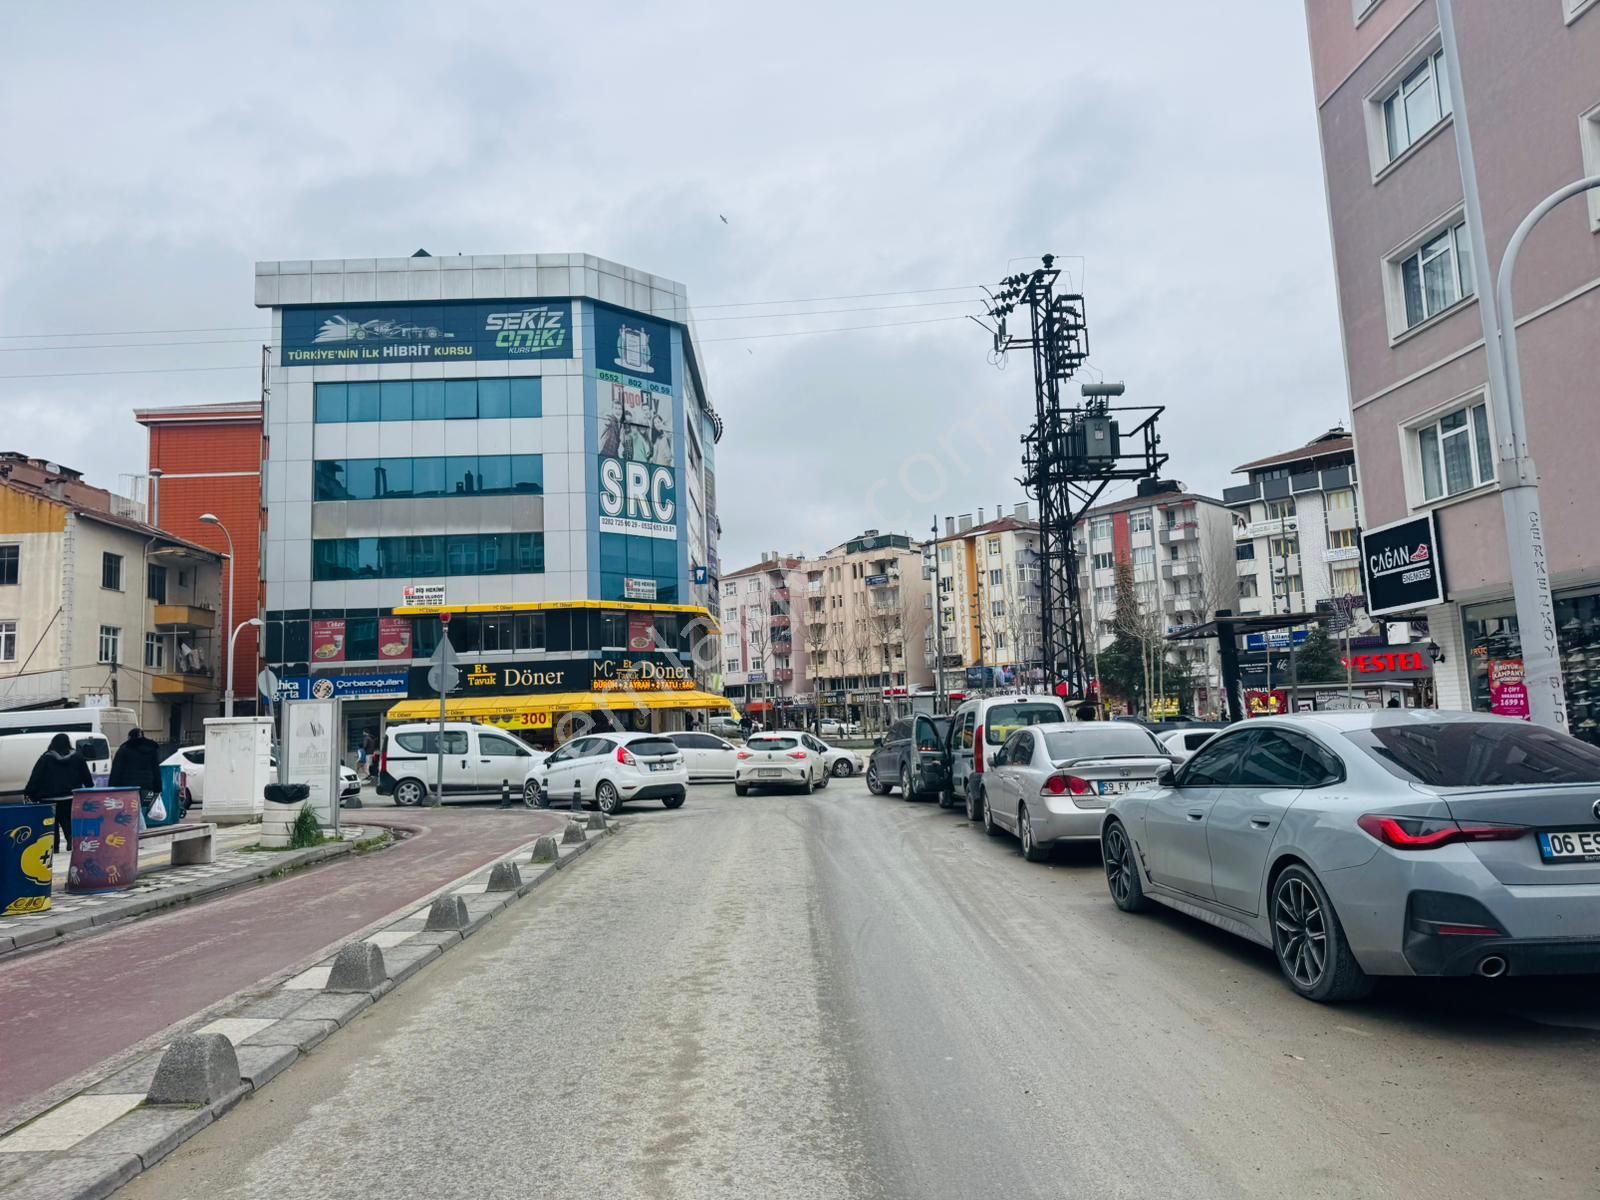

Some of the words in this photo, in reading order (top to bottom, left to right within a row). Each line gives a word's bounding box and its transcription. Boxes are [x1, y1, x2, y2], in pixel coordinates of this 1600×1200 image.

[288, 350, 358, 360] TÜRKİYE'NİN
[362, 349, 379, 358] İLK
[383, 345, 430, 357] HİBRİT
[434, 346, 472, 356] KURSU
[599, 372, 619, 383] 0552
[628, 379, 642, 388] 802
[600, 457, 675, 522] SRC
[1370, 546, 1409, 578] ÇAĞAN
[474, 664, 488, 673] Et
[623, 660, 632, 668] Et
[642, 661, 691, 679] Döner
[1341, 652, 1426, 673] VESTEL
[277, 679, 299, 690] hica
[467, 676, 497, 686] Tavuk
[503, 669, 565, 687] Döner
[521, 713, 547, 725] 300
[1551, 834, 1575, 854] 06
